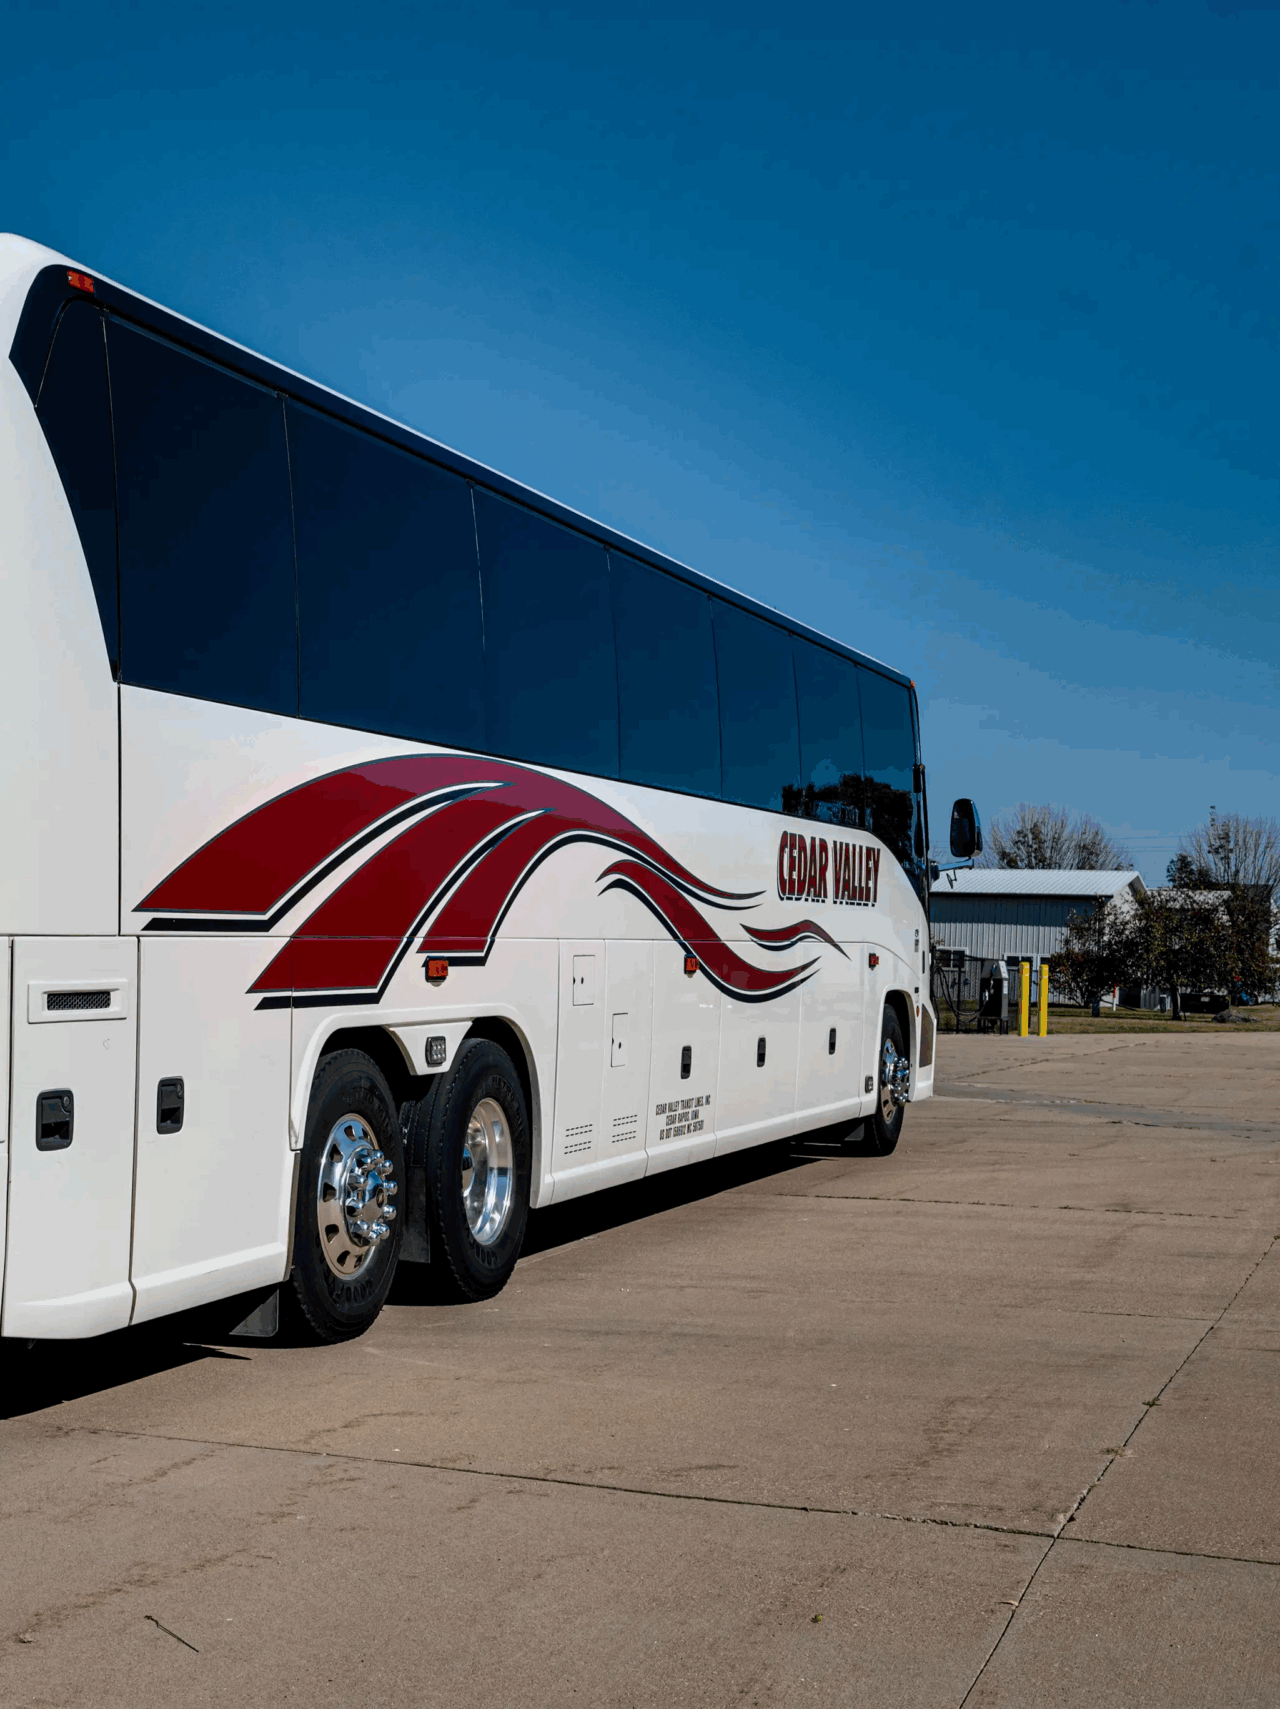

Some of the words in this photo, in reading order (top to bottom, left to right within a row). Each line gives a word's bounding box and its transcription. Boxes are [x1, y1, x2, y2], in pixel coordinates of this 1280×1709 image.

[777, 830, 829, 903] CEDAR
[832, 840, 881, 907] VALLEY
[656, 1103, 667, 1115] CEDAR
[668, 1101, 680, 1112] VALLEY
[680, 1098, 694, 1110] TRANSIT
[666, 1114, 677, 1126] CEDAR
[691, 1109, 699, 1120] IOWA
